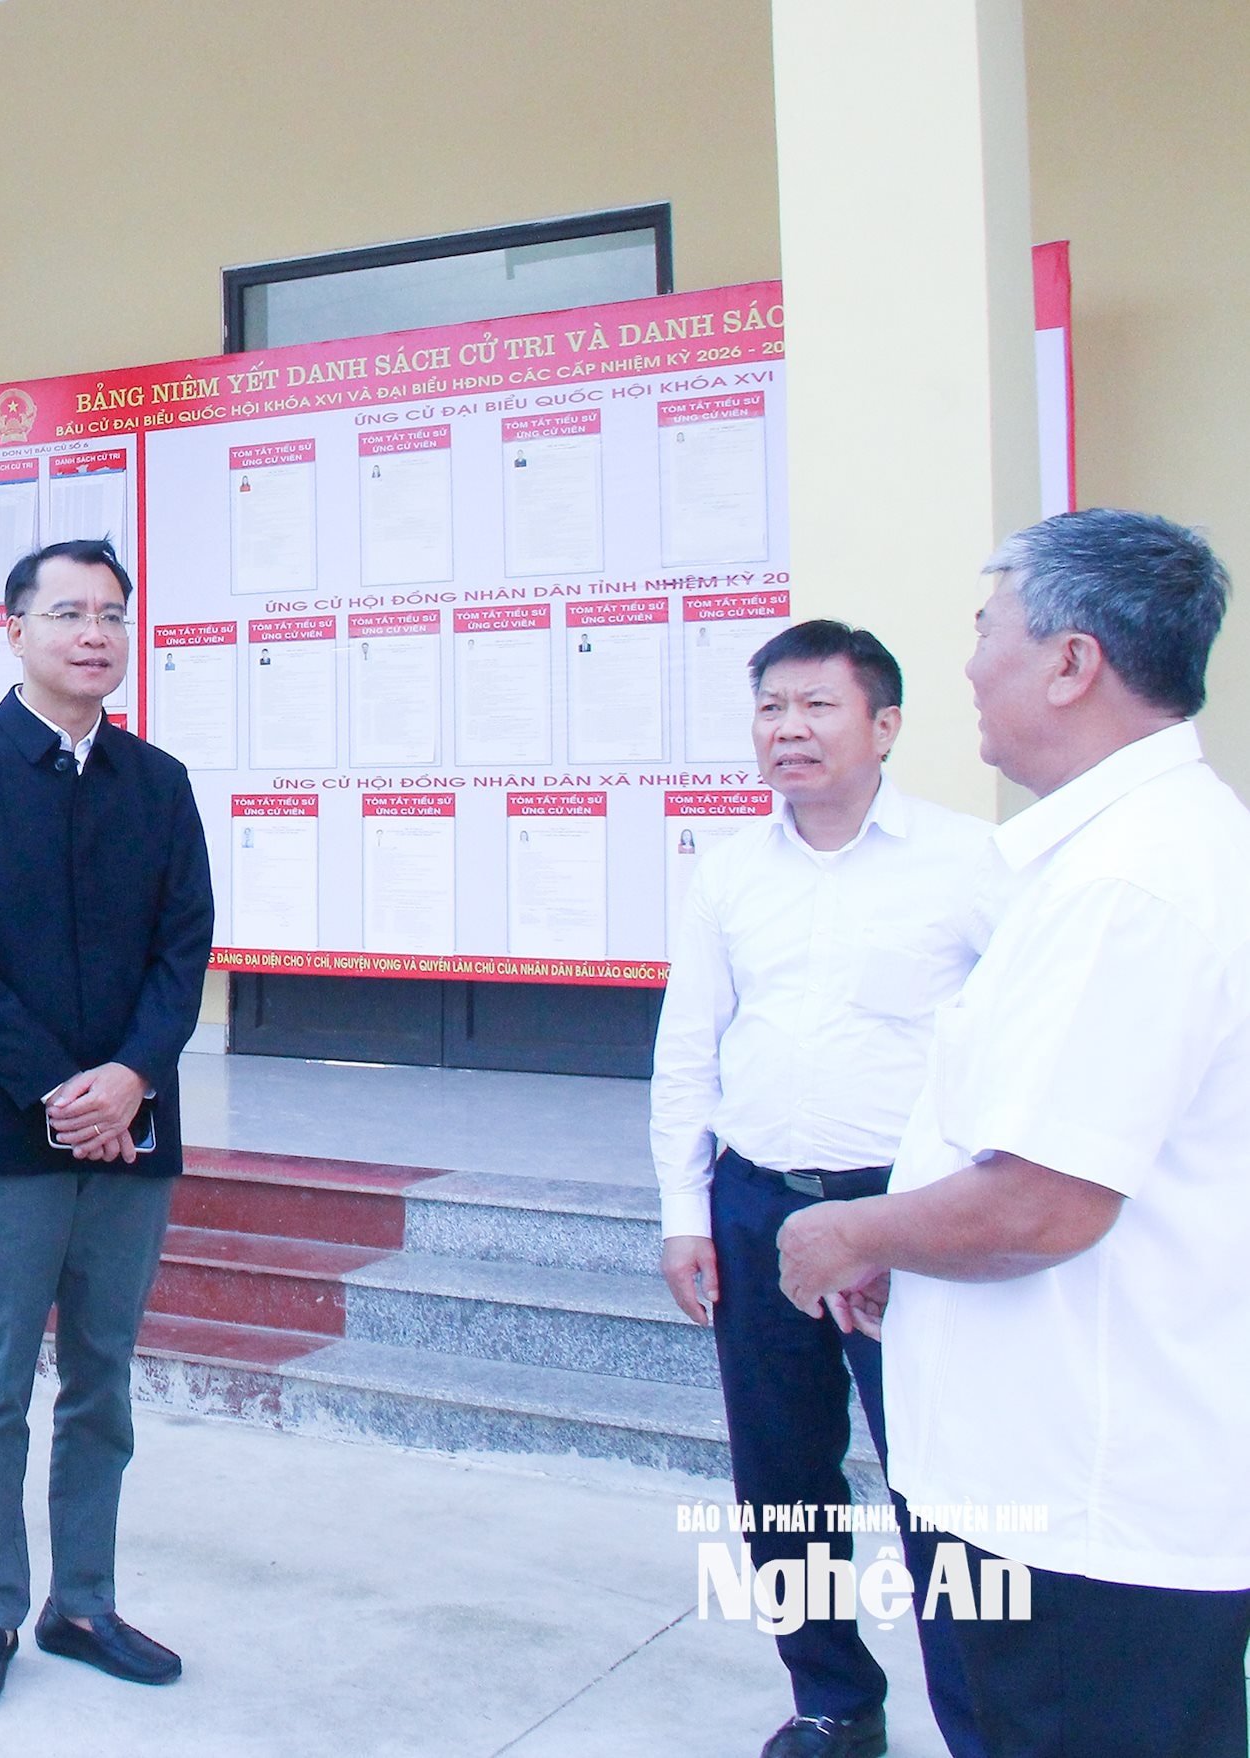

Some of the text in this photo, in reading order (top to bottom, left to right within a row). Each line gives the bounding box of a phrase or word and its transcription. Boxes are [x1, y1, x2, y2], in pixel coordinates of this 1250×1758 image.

[76, 382, 144, 413] BẢNG
[151, 374, 219, 404] NIÊM
[227, 360, 278, 394] YẾT
[287, 357, 367, 387] DANH
[374, 346, 450, 376] SÁCH
[459, 332, 498, 366] CỬ
[504, 335, 555, 361] TRI
[565, 322, 609, 353] VÀ
[618, 314, 714, 347] DANH
[88, 416, 109, 432] CỬ
[113, 417, 139, 431] ĐẠI
[144, 408, 173, 426] BIỂU
[178, 405, 226, 423] QUỐC
[231, 401, 259, 417] HỘI
[264, 393, 311, 412] KHÓA
[315, 392, 342, 406] XVI
[348, 383, 372, 402] VÀ
[377, 386, 406, 400] ĐẠI
[413, 377, 447, 394] BIỂU
[452, 373, 504, 390] HĐND
[509, 365, 550, 384] CÁC
[557, 359, 596, 379] CẤP
[601, 355, 661, 374] NHIỆM
[667, 349, 691, 366] KỲ
[696, 346, 742, 362] 2026
[354, 370, 774, 426] ỨNG CỬ ĐẠI BIỂU QUỐC HỘI KHÓA XVI
[265, 599, 308, 613] ỨNG
[314, 595, 343, 610] CỬ
[349, 593, 384, 610] HỘI
[391, 590, 457, 606] ĐỒNG
[464, 587, 526, 601] NHÂN
[534, 580, 581, 598] DÂN
[588, 576, 636, 594] TỈNH
[273, 776, 316, 790] ỨNG
[322, 775, 350, 789] CỬ
[357, 776, 393, 791] HỘI
[400, 774, 466, 788] ĐỒNG
[473, 774, 535, 788] NHÂN
[543, 773, 591, 787] DÂN
[599, 772, 630, 786] XÃ
[639, 772, 712, 788] NHIỆM
[720, 770, 751, 785] KỲ
[217, 949, 243, 965] ĐÁNG
[245, 953, 260, 968] ĐẠI
[262, 951, 281, 969] DIỆN
[283, 955, 304, 967] CHO
[305, 953, 312, 967] Ý
[313, 953, 332, 970] CHÍ,
[333, 955, 371, 972] NGUYỆN
[373, 957, 401, 973] VỌNG
[403, 955, 417, 970] VÀ
[418, 956, 450, 972] QUYỀN
[452, 958, 472, 973] LÀM
[474, 958, 495, 974] CHỦ
[497, 959, 518, 975] CỦA
[520, 960, 548, 976] NHÂN
[551, 962, 573, 976] DÂN
[575, 961, 595, 977] BẦU
[598, 963, 621, 978] VÀO
[623, 963, 655, 980] QUỐC
